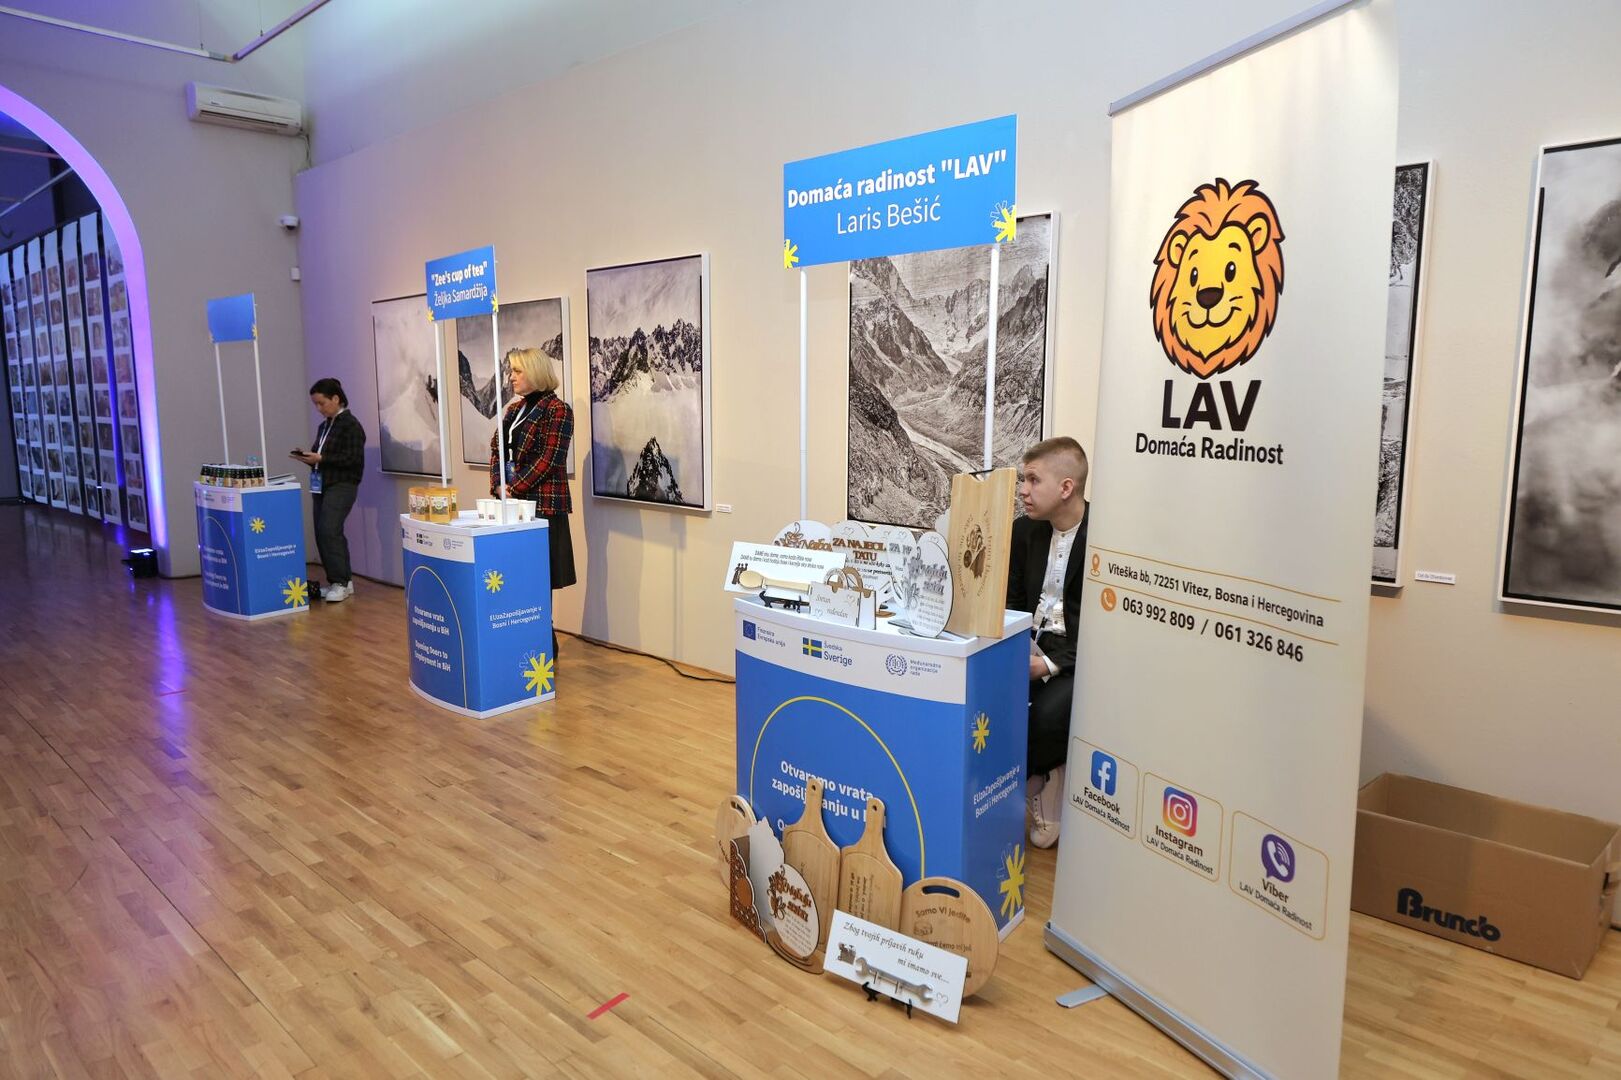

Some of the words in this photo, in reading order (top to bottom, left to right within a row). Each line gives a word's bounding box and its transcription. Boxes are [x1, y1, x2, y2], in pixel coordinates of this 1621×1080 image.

[788, 178, 852, 208] Domaća
[857, 163, 935, 196] radinost
[941, 149, 1007, 180] "LAV"
[837, 206, 881, 235] Laris
[887, 194, 941, 228] Bešić
[431, 270, 451, 286] "Zee's
[451, 270, 463, 284] cup
[464, 264, 472, 279] of
[472, 260, 488, 276] tea"
[434, 291, 452, 308] Željka
[452, 283, 488, 302] Samardžija
[1162, 379, 1262, 431] LAV
[1136, 433, 1196, 458] Domaća
[1201, 437, 1284, 465] Radinost
[1108, 562, 1138, 581] Viteška
[1139, 569, 1152, 586] bb,
[1153, 573, 1180, 592] 72251
[1182, 580, 1212, 600] Vitez,
[1215, 587, 1249, 607] Bosna
[1251, 595, 1256, 608] i
[1257, 599, 1324, 627] Hercegovina
[1122, 597, 1143, 616] 063
[1146, 604, 1167, 623] 992
[1169, 611, 1195, 631] 809
[1200, 619, 1209, 635] /
[1215, 622, 1242, 643] 061
[1246, 629, 1273, 652] 326
[1276, 639, 1304, 662] 846
[824, 651, 853, 667] Sverige
[851, 809, 860, 820] u
[1072, 794, 1084, 806] LAV
[1107, 812, 1130, 833] Radinost
[1084, 786, 1121, 815] Facebook
[1146, 835, 1160, 847] LAV
[1185, 854, 1214, 875] Radinost
[1155, 825, 1203, 857] Instagram
[1239, 882, 1254, 895] LAV
[1282, 905, 1312, 931] Radinost
[1262, 878, 1289, 903] Viber
